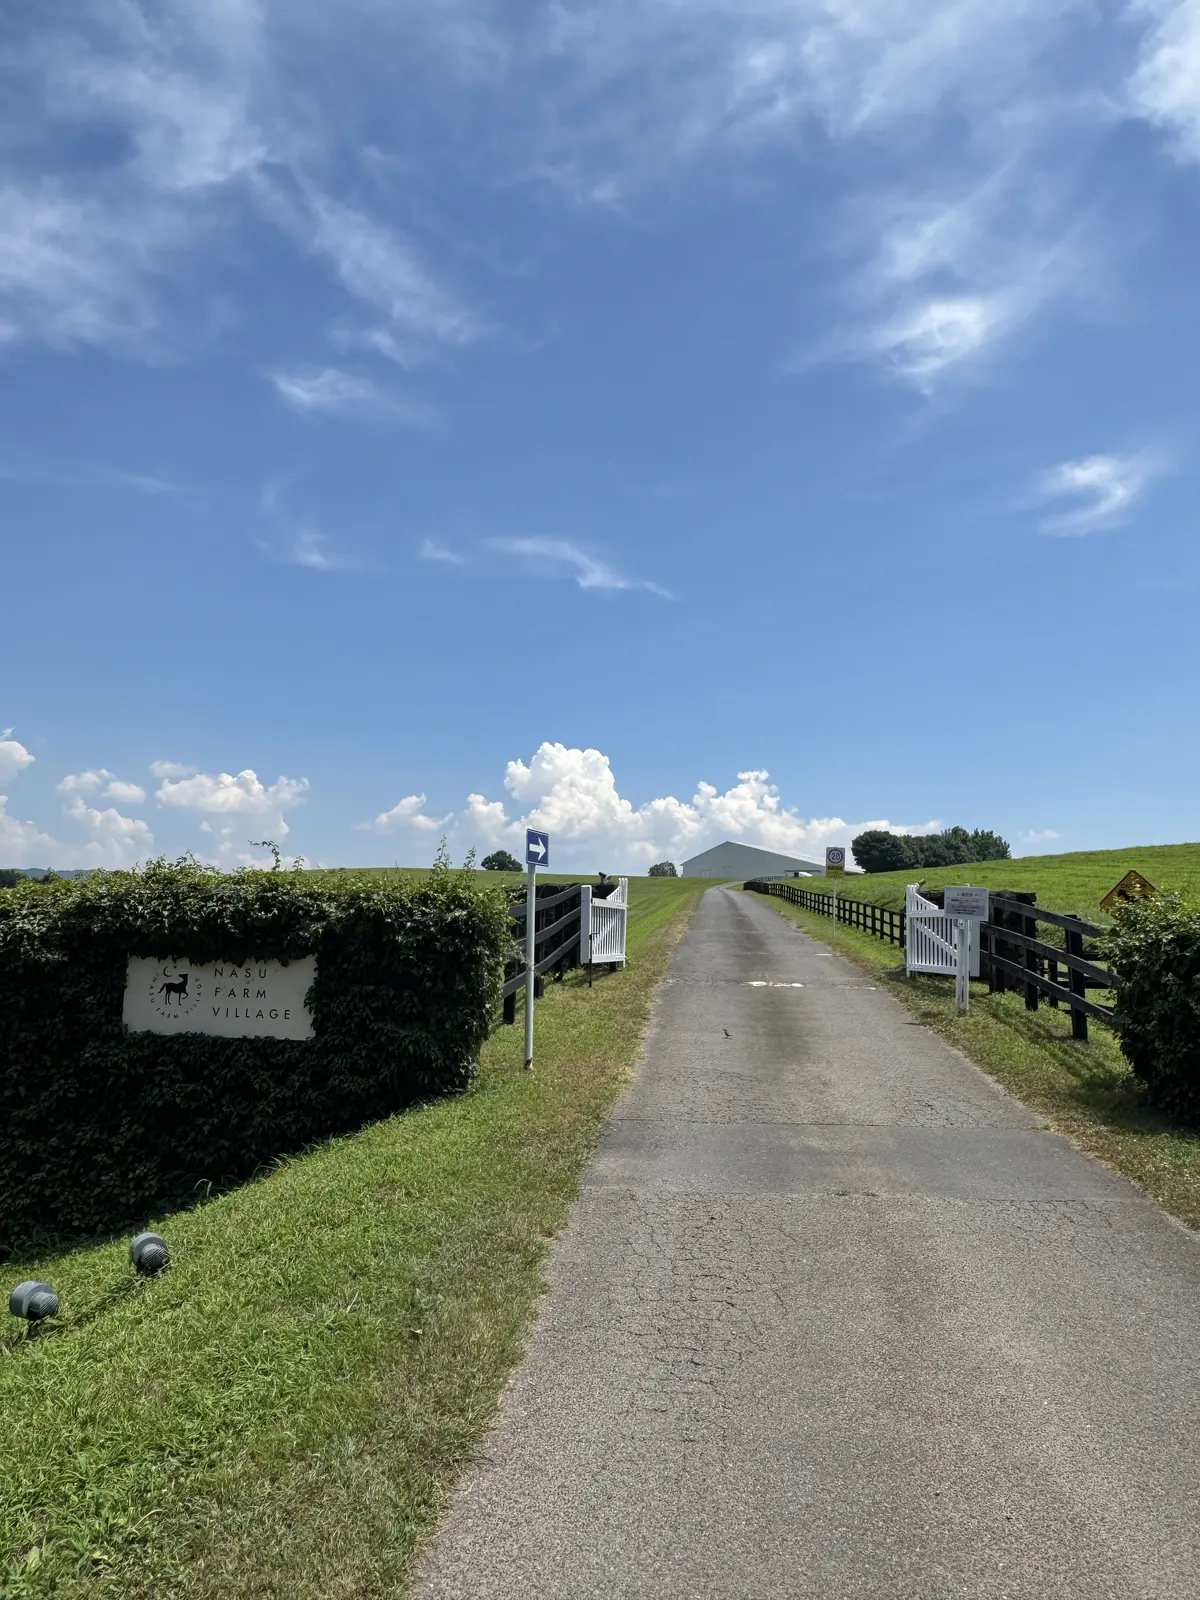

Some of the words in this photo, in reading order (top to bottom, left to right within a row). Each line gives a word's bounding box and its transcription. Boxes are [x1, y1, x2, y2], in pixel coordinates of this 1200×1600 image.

[831, 851, 841, 861] 20
[214, 967, 267, 978] NASU
[214, 987, 267, 998] FARM
[212, 1006, 291, 1020] VILLAGE
